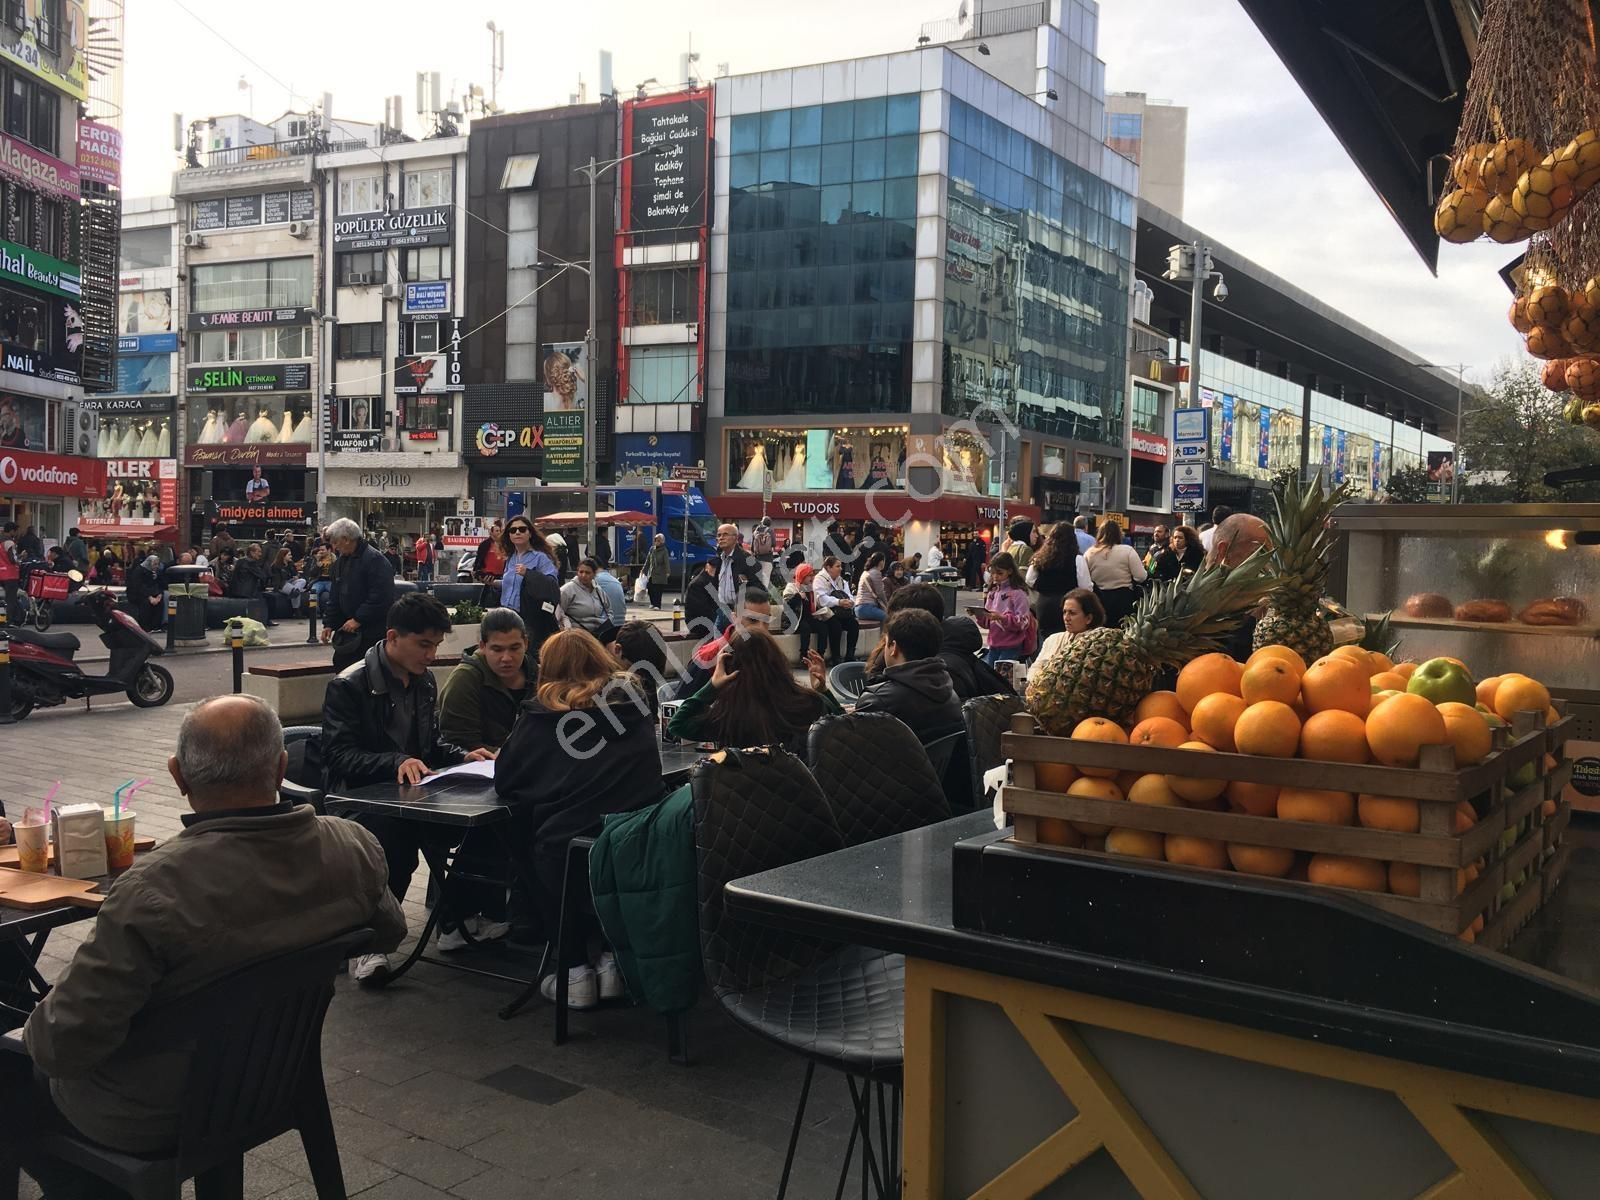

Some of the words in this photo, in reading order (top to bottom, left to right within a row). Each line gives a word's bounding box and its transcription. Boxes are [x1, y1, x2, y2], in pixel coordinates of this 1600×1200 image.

[652, 114, 688, 127] Tahtakale
[655, 160, 683, 172] Kadıköy
[654, 176, 684, 188] Tophane
[653, 190, 672, 203] şimdi
[674, 189, 683, 200] de
[647, 204, 689, 216] Bakırköy'de
[334, 217, 385, 234] POPÜLER
[390, 210, 446, 229] GÜZELLİK
[28, 263, 58, 286] Beauty
[242, 311, 273, 322] BEAUTY
[452, 319, 461, 384] TATTOO
[7, 354, 34, 373] NAİL
[204, 367, 242, 387] SELİN
[106, 400, 142, 409] KARACA
[547, 416, 581, 426] ALTIER
[334, 438, 368, 447] KUAFÖRÜ
[482, 430, 515, 449] CEP
[21, 464, 78, 485] vodafone
[359, 471, 411, 490] raspino
[220, 506, 265, 518] midyeci
[267, 506, 303, 518] ahmet
[793, 503, 840, 514] TUDORS
[667, 708, 672, 716] 1
